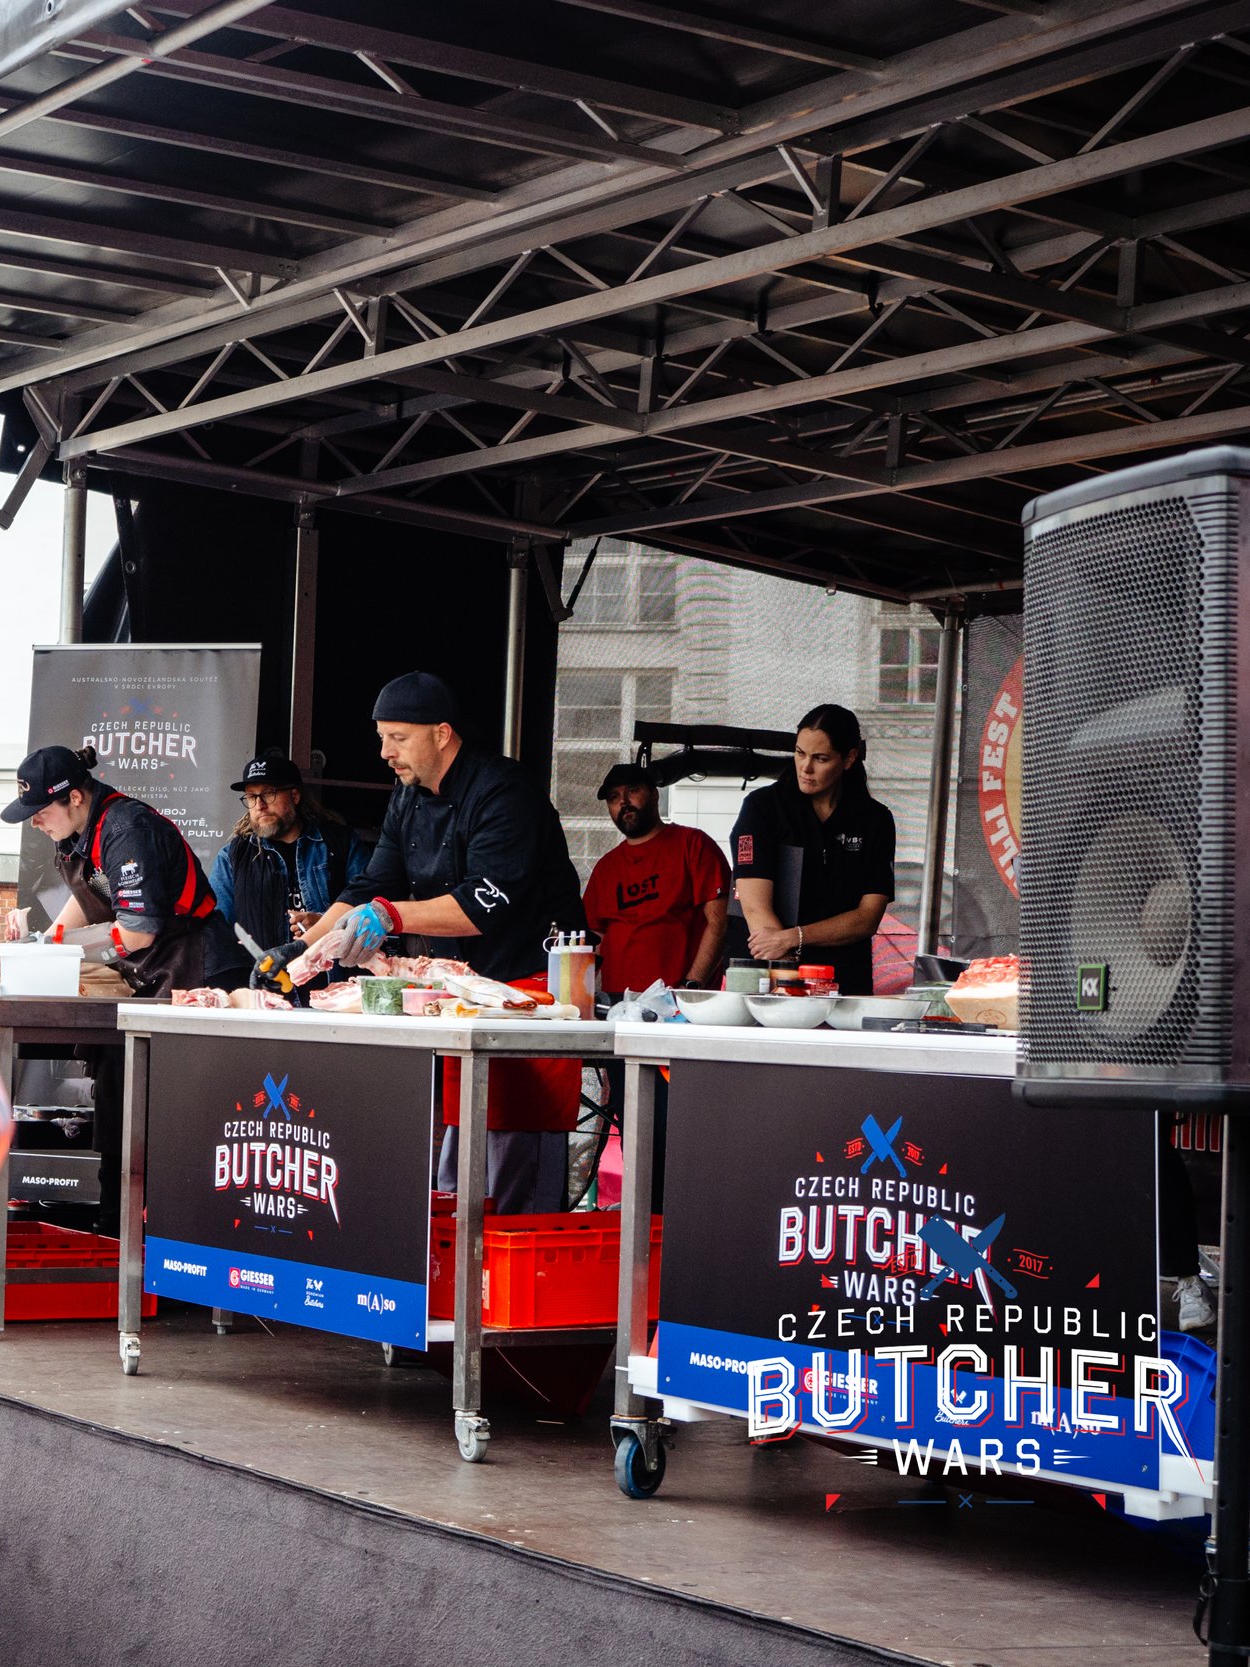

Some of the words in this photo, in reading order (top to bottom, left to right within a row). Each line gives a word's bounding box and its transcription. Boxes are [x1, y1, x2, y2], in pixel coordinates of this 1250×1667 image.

[91, 721, 128, 733] CZECH
[134, 721, 191, 733] REPUBLIC
[82, 731, 198, 769] BUTCHER
[982, 690, 1019, 793] FEST
[118, 758, 159, 770] WARS
[156, 808, 187, 816] UBOJ
[171, 817, 209, 827] TIVITĚ,
[187, 830, 224, 838] PULTU
[617, 873, 660, 911] LOST
[224, 1121, 263, 1138] CZECH
[269, 1121, 330, 1149] REPUBLIC
[214, 1142, 340, 1226] BUTCHER
[795, 1176, 859, 1198] CZECH
[871, 1178, 976, 1217] REPUBLIC
[253, 1192, 296, 1219] WARS
[240, 1269, 275, 1287] GIESSER
[843, 1270, 917, 1307] WARS
